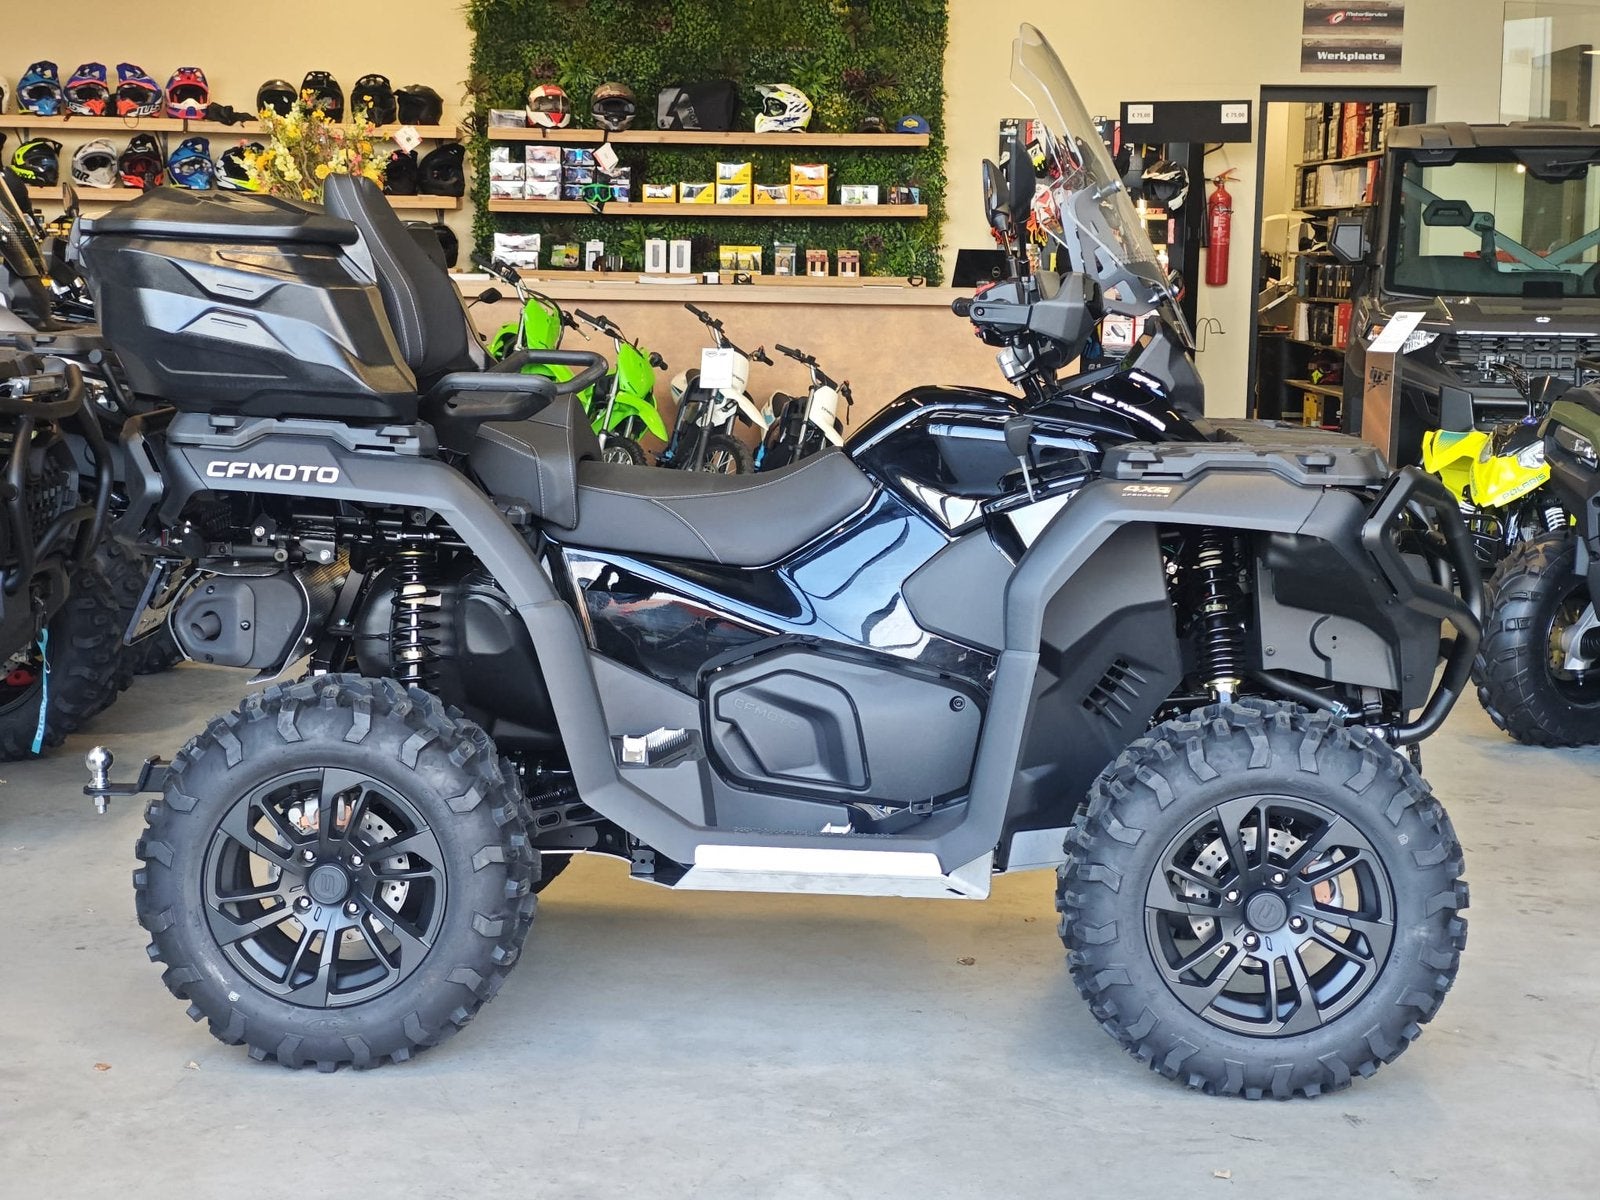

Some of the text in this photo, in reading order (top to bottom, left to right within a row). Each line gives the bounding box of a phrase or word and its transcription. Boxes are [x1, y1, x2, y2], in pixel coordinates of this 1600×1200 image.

[1317, 51, 1386, 62] Werkplaats
[206, 460, 340, 484] CFMOTO
[1502, 472, 1547, 500] POLARIS
